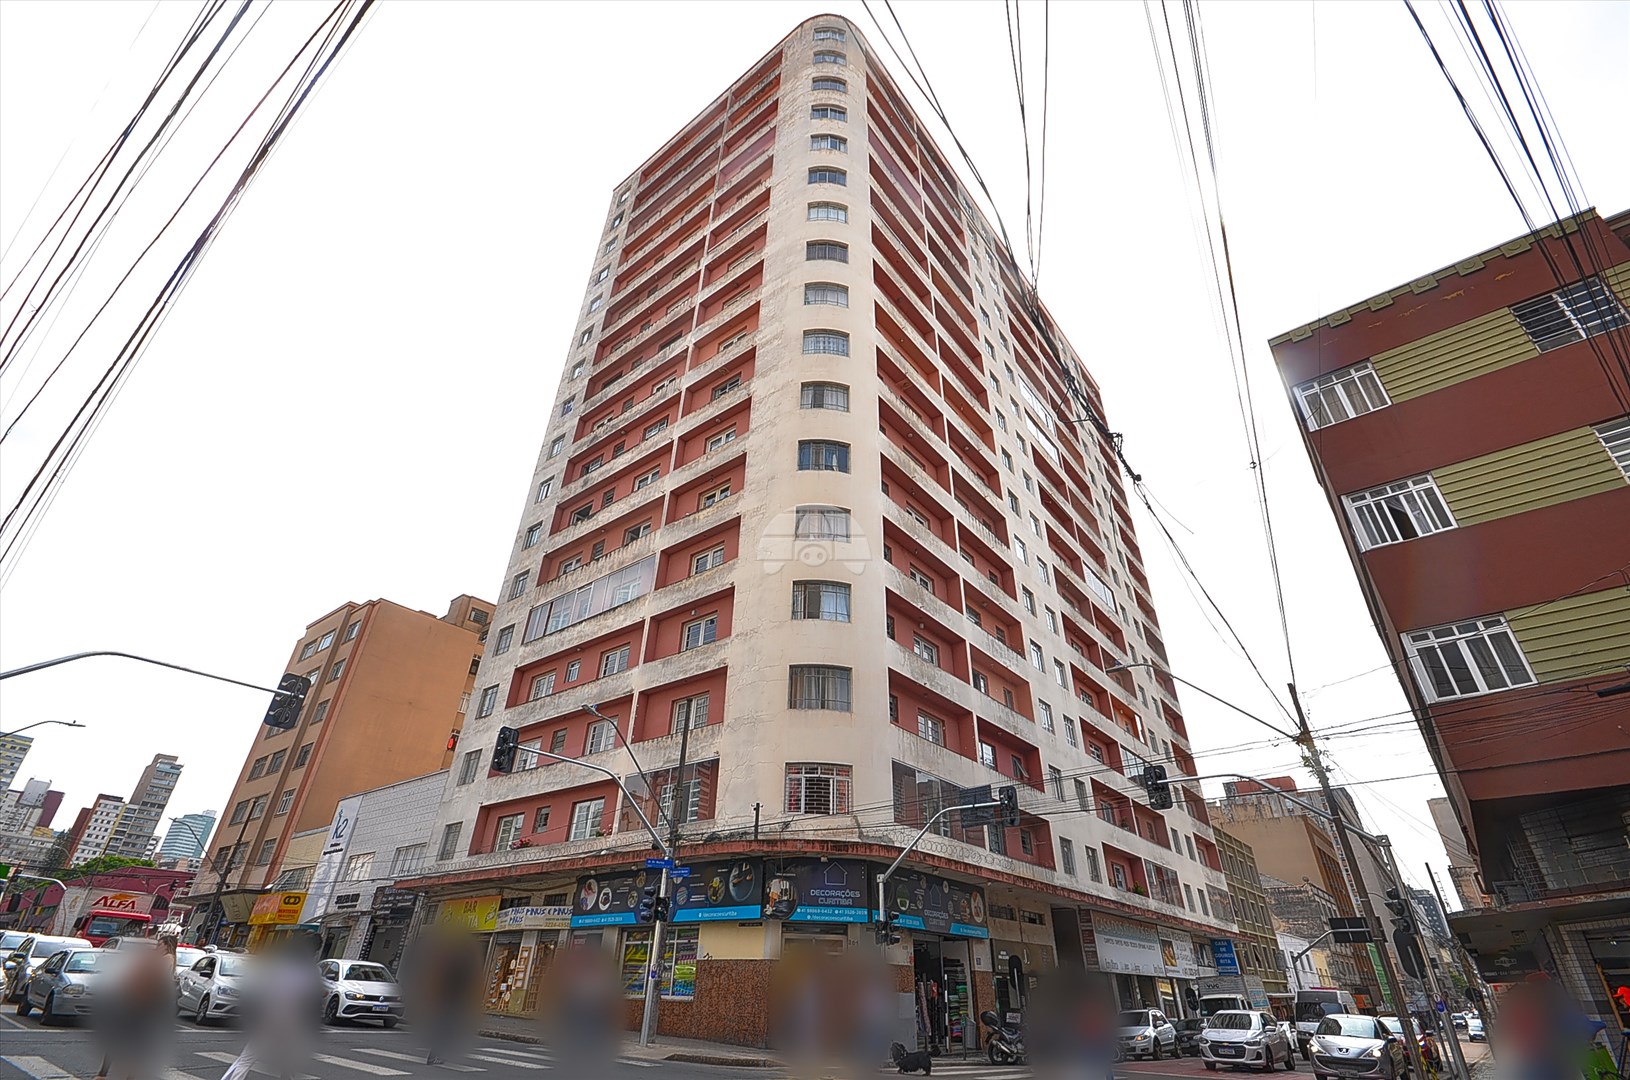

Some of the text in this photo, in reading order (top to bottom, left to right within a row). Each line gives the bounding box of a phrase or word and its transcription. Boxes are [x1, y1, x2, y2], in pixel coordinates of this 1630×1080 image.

[810, 889, 861, 898] DECORAÇÕES
[91, 895, 136, 910] ALFA
[463, 900, 478, 913] BAR
[525, 908, 546, 916] PINUS
[553, 907, 574, 916] PINUS
